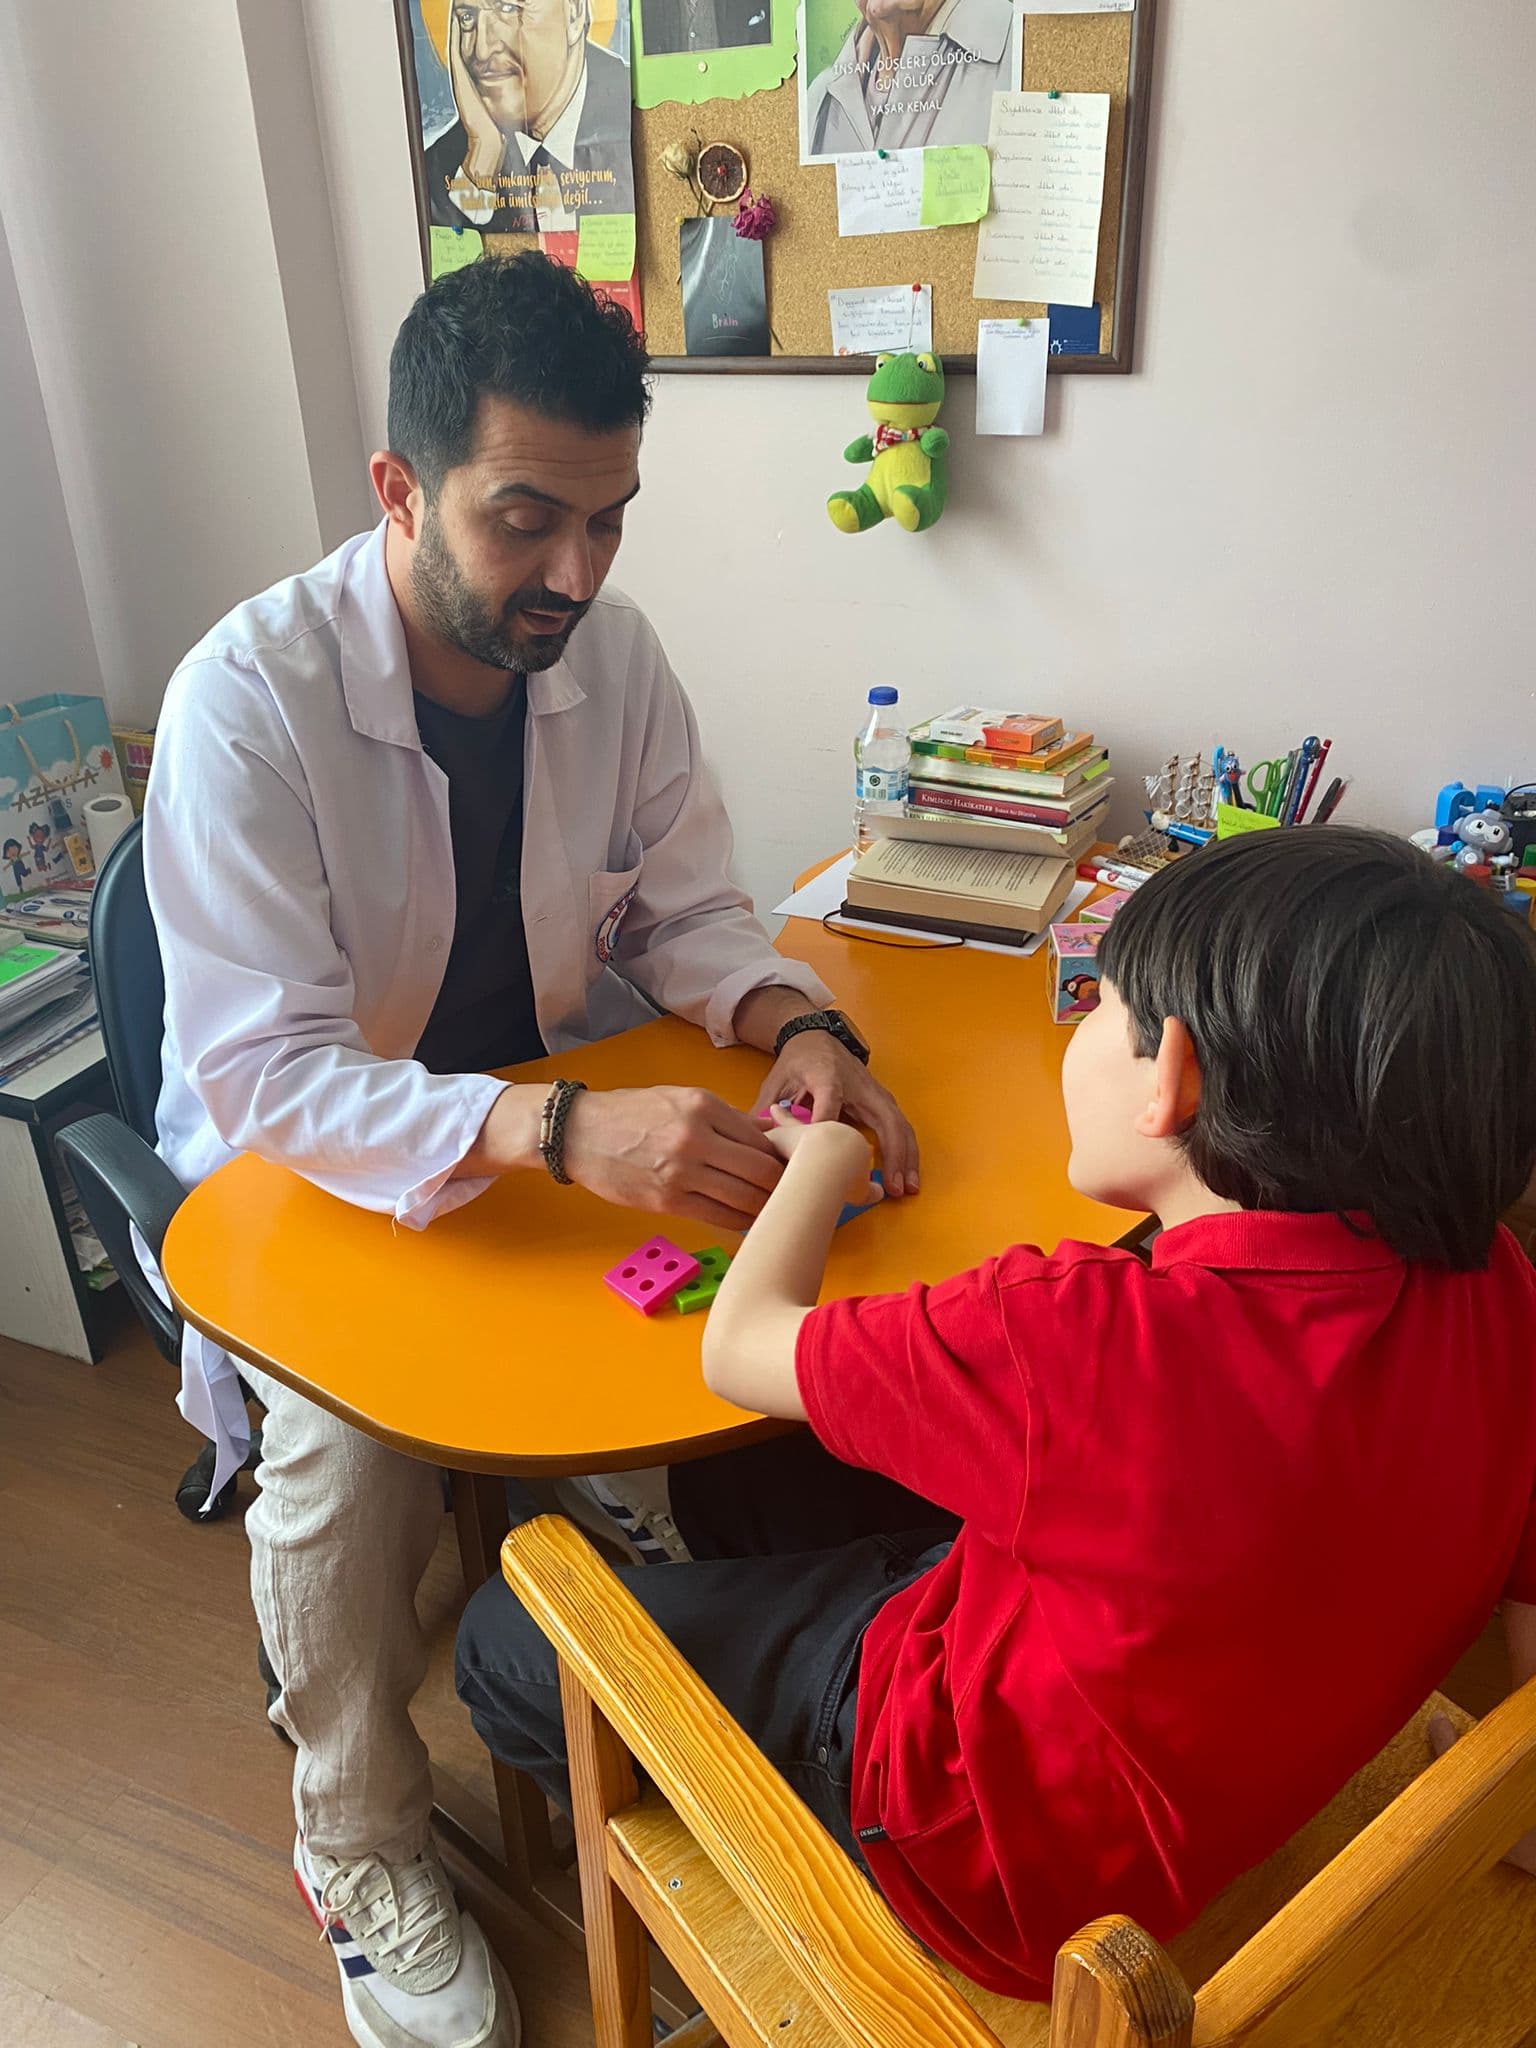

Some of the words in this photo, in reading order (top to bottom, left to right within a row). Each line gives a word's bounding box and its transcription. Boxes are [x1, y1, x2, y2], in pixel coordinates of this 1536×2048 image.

[875, 75, 900, 91] GÜN
[906, 100, 943, 114] KEMAL
[560, 168, 617, 187] seviyorum,
